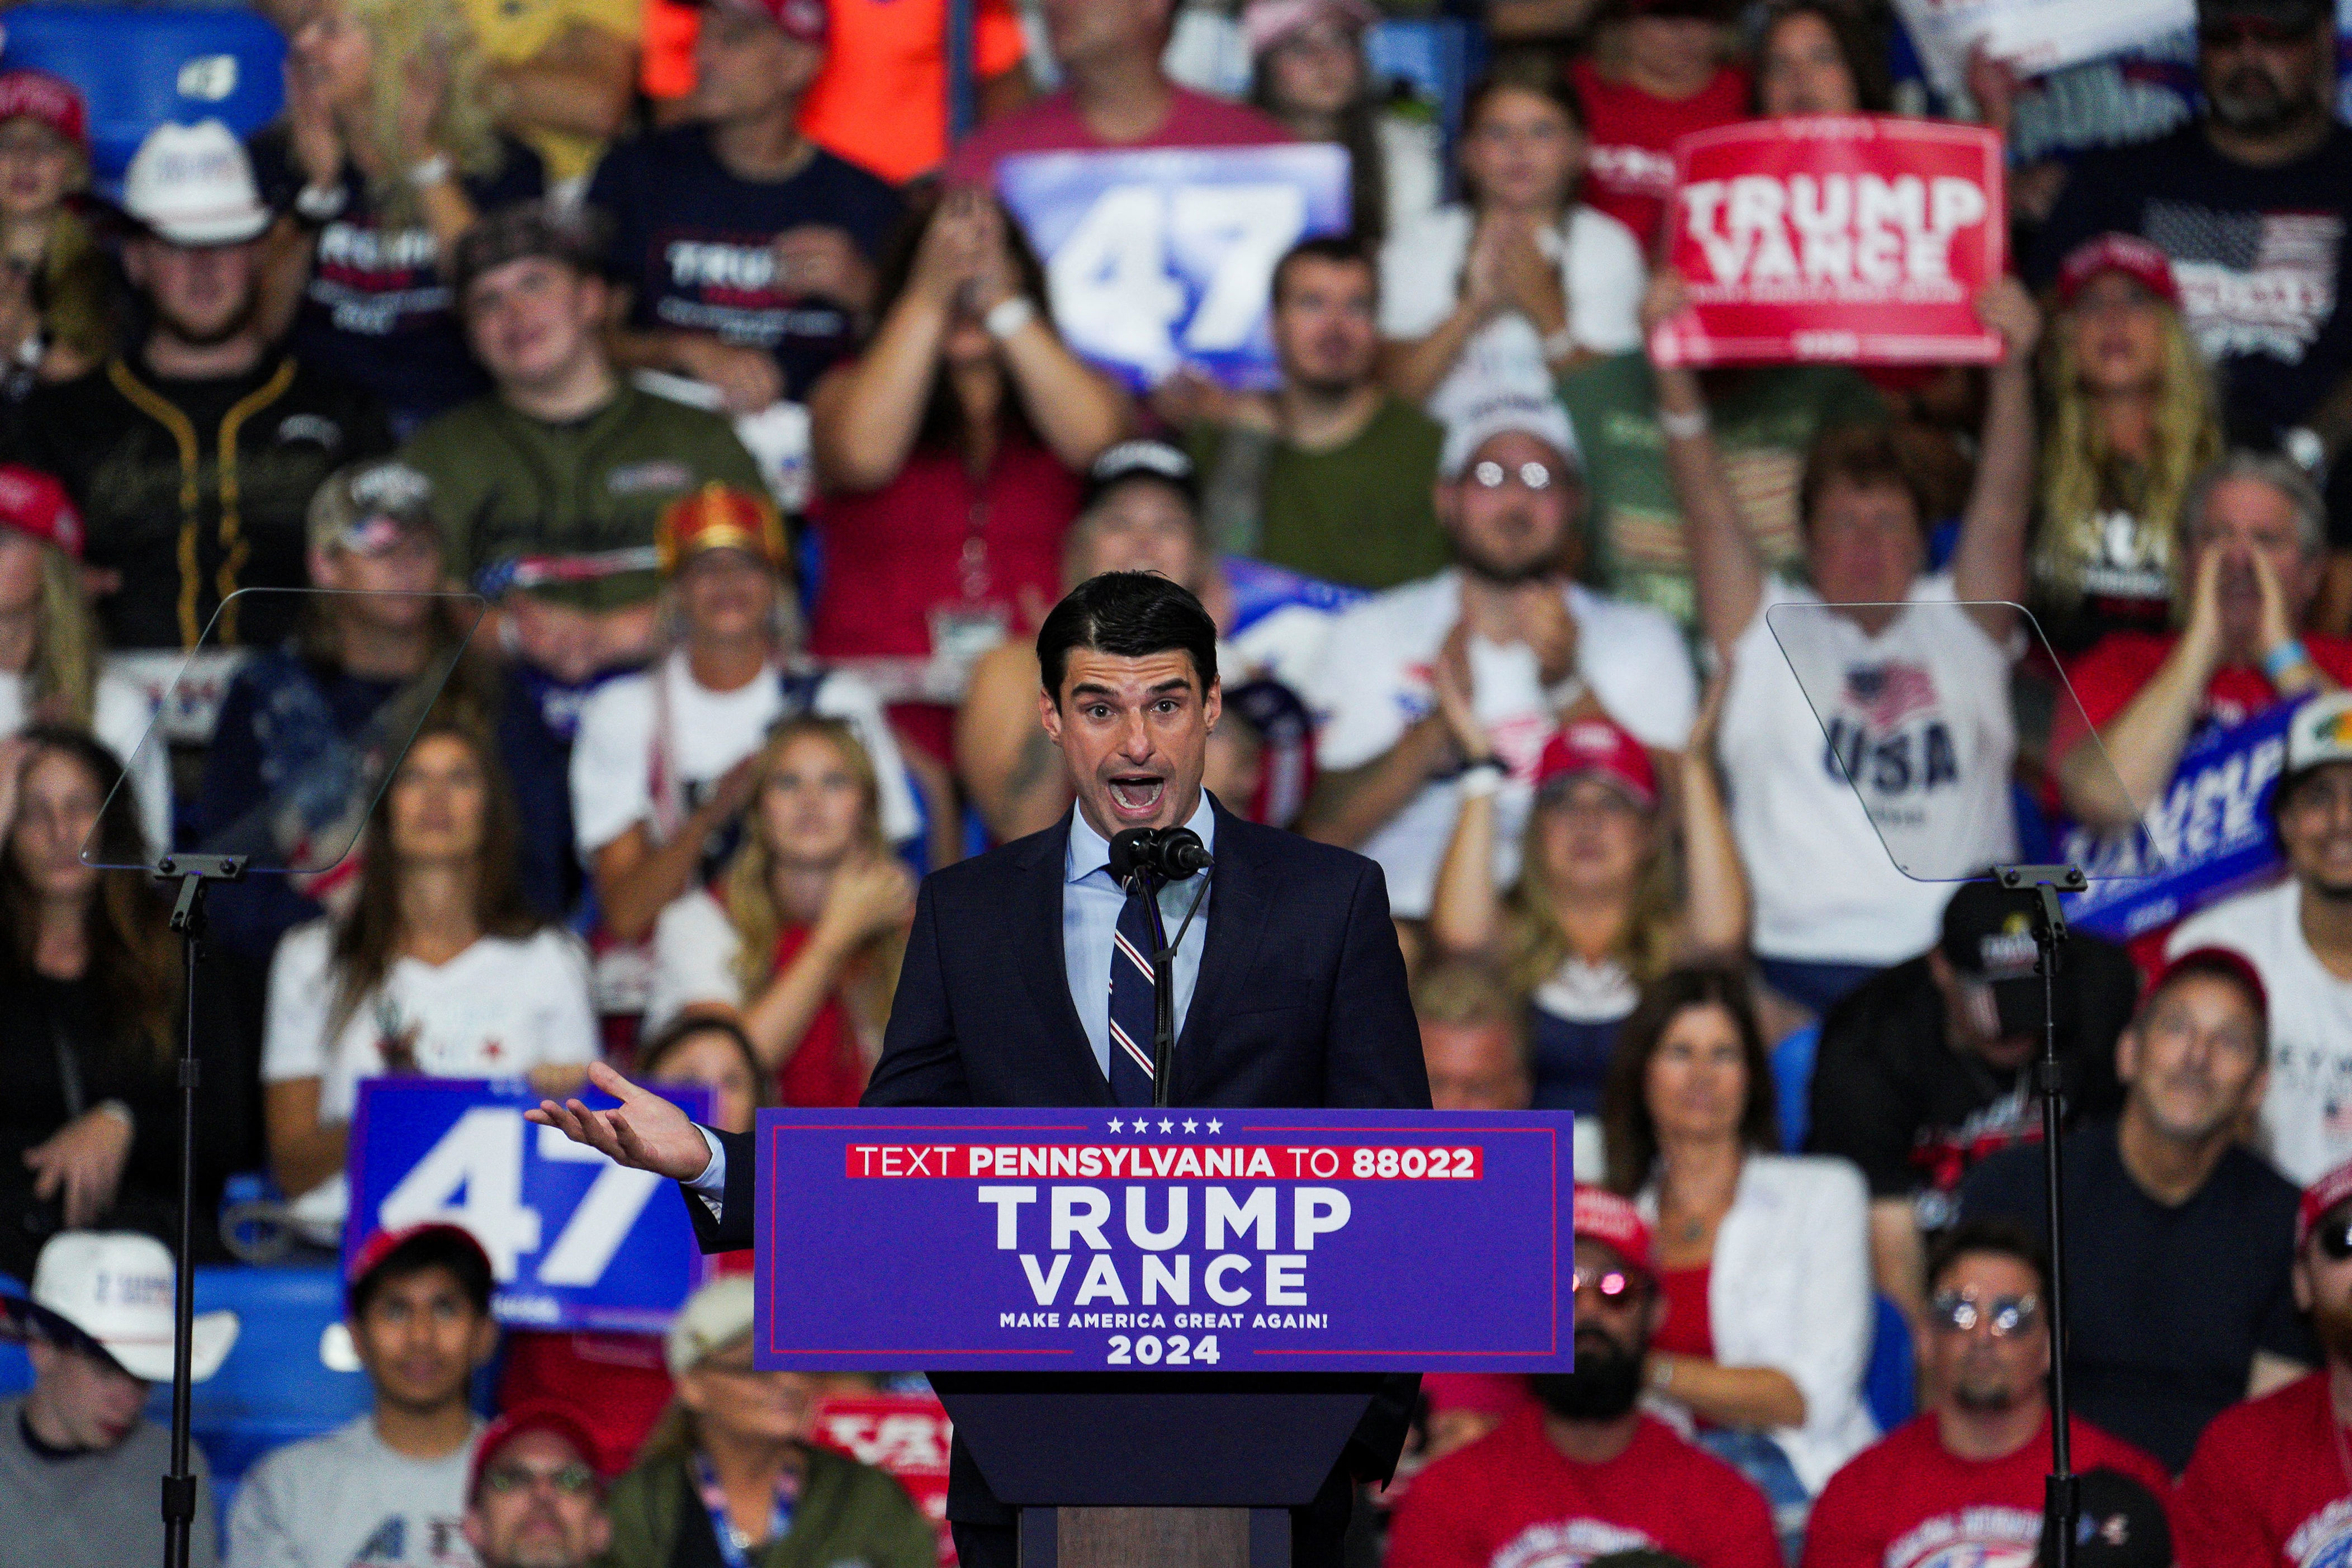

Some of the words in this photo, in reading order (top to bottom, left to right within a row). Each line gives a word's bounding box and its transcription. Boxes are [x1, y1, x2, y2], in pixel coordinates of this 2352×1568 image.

[1683, 172, 1986, 235] TRUMP
[1047, 182, 1305, 358] 47
[1701, 228, 1949, 283] VANCE
[1823, 718, 1958, 794] USA
[855, 1147, 956, 1176] TEXT
[969, 1147, 1275, 1177] PENNSYLVANIA
[1287, 1148, 1340, 1178] TO
[1352, 1148, 1474, 1178] 88022
[380, 1105, 663, 1287] 47
[978, 1186, 1352, 1251] TRUMP
[1019, 1253, 1308, 1306] VANCE
[1000, 1313, 1059, 1328] MAKE
[1068, 1313, 1166, 1329] AMERICA
[1174, 1313, 1244, 1329] GREAT
[1252, 1313, 1328, 1329] AGAIN!
[1107, 1335, 1220, 1365] 2024
